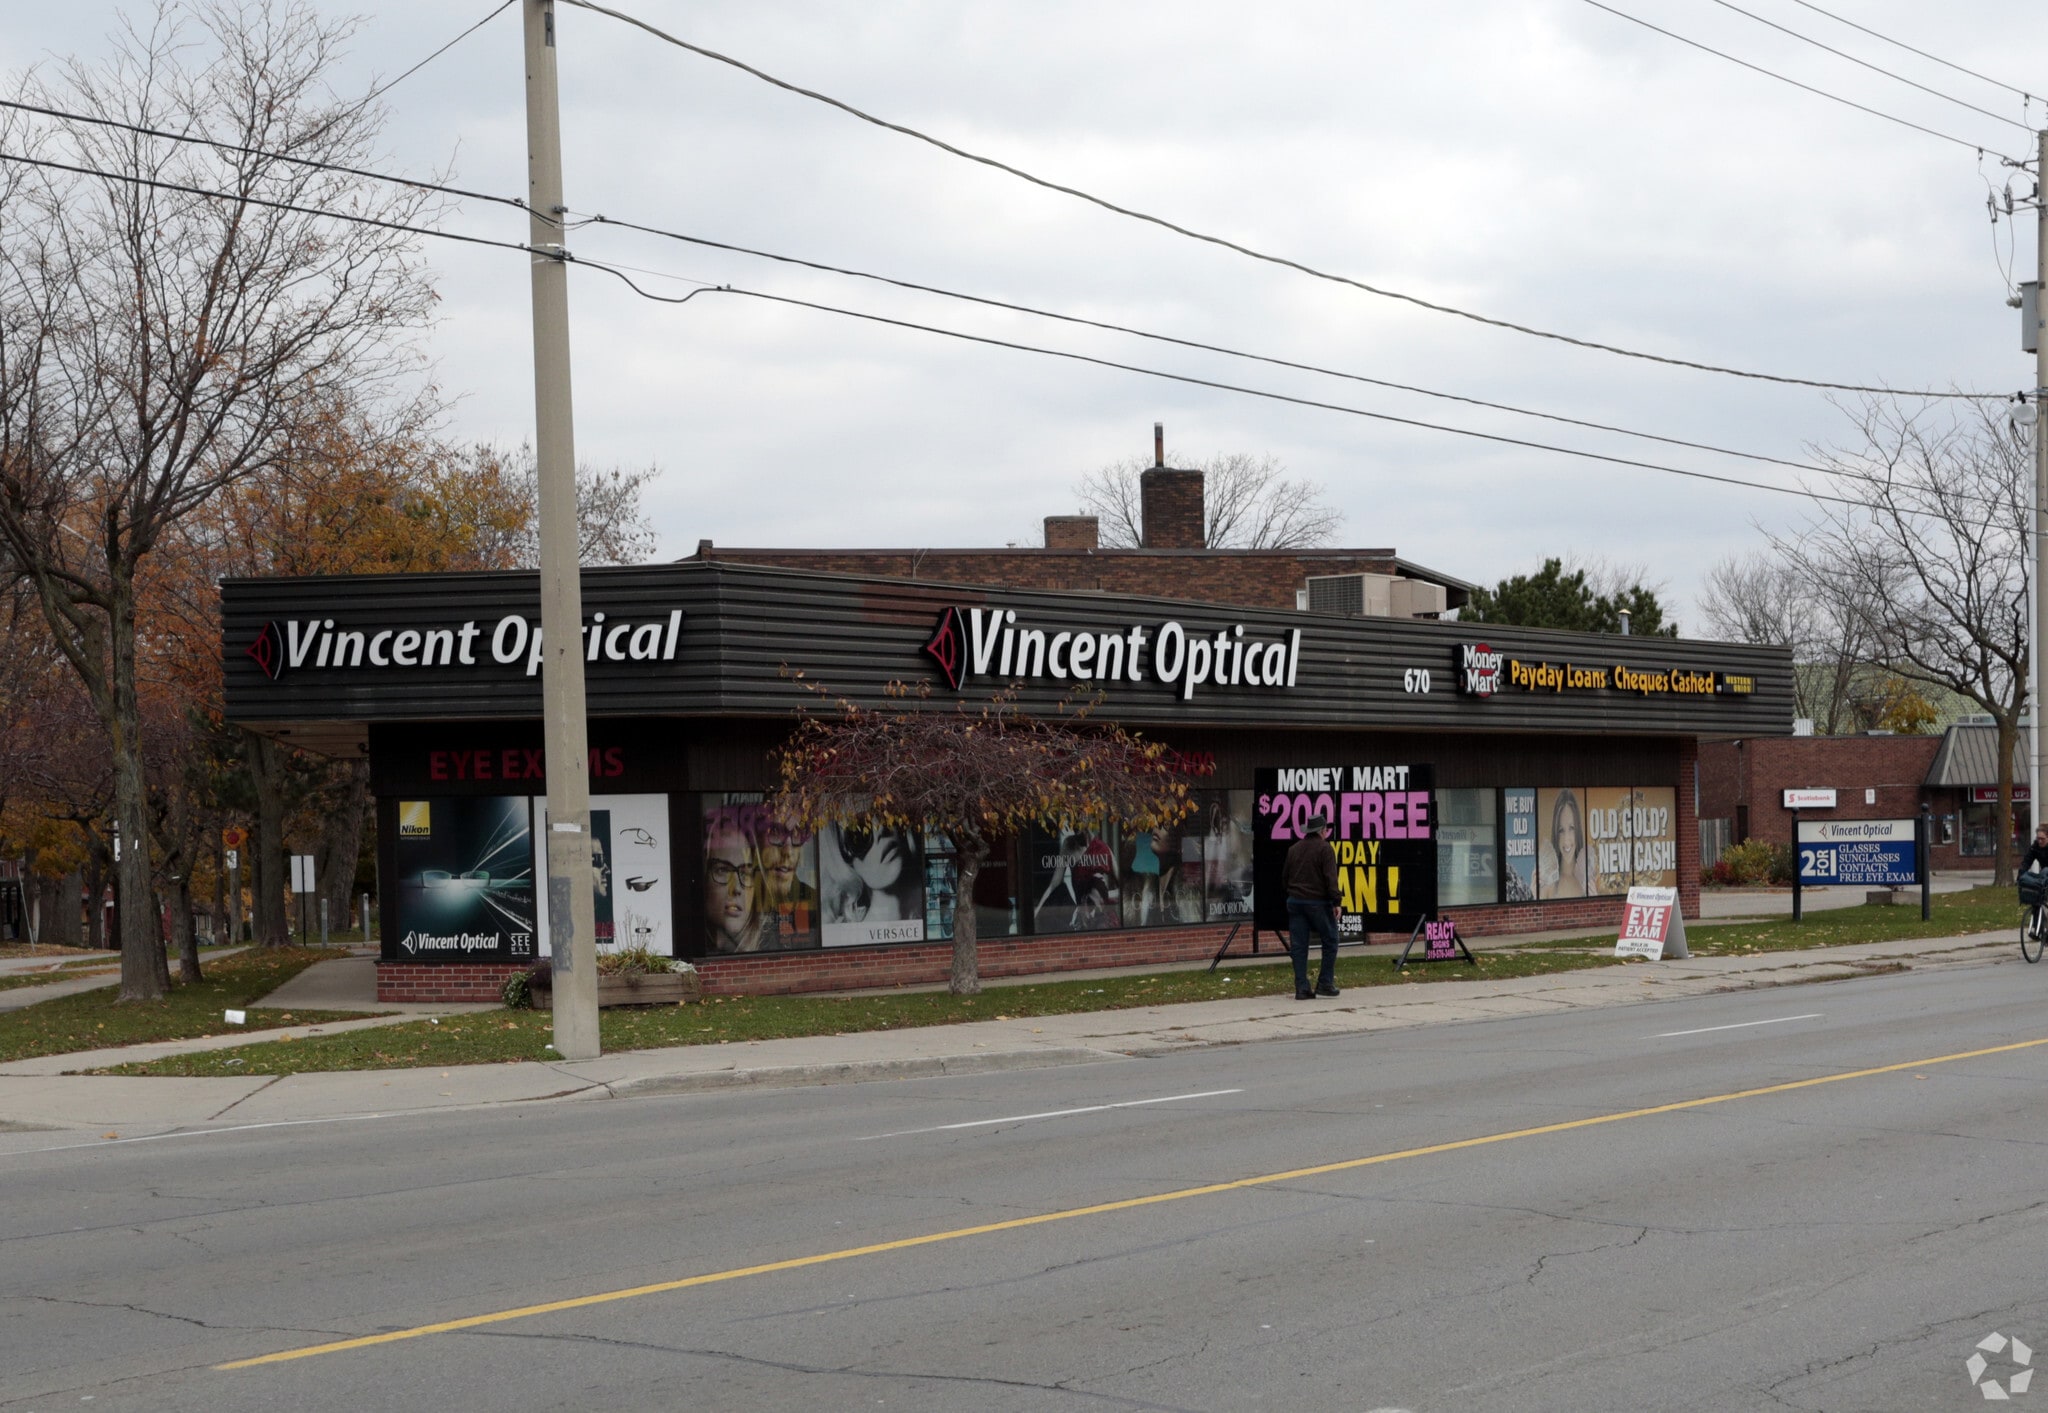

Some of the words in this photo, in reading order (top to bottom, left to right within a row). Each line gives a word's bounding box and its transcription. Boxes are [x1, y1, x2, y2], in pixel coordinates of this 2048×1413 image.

[287, 618, 481, 668] Vincent
[491, 609, 683, 677] Opical
[970, 608, 1146, 681] Vincent
[1153, 621, 1300, 700] Optical
[1462, 644, 1504, 677] Money
[1404, 667, 1430, 694] 670
[1466, 669, 1499, 693] Mart
[1511, 659, 1564, 693] Payday
[1566, 662, 1606, 689] Loans
[1614, 665, 1669, 696] Cheques
[1670, 668, 1715, 694] Cashed
[1725, 675, 1752, 685] WESTERN
[1733, 684, 1752, 693] UNION
[430, 749, 492, 781] EYE
[502, 747, 625, 780] EXMS
[1277, 767, 1343, 792] MONEY
[1353, 765, 1409, 791] MART
[1505, 796, 1518, 813] WE
[1519, 796, 1535, 813] BUY
[1340, 791, 1431, 840] FREE
[1590, 808, 1618, 840] OLD
[1622, 806, 1668, 838] GOLD?
[401, 825, 429, 834] Nikon
[1513, 818, 1528, 835] OLD
[1831, 824, 1861, 836] Vincent
[1863, 823, 1893, 838] Optical
[1329, 841, 1380, 865] YDAY
[1507, 839, 1535, 857] SILVER!
[1838, 844, 1880, 853] GLASSES
[1041, 854, 1076, 868] GIORGIO
[1077, 853, 1109, 867] ARMANI
[1599, 842, 1632, 874] NEW
[1634, 841, 1676, 872] CASH!
[1800, 849, 1816, 877] 2
[1816, 849, 1829, 877] FOR
[1839, 853, 1900, 863] SUNGLASSES
[1839, 863, 1888, 872] CONTACTS
[1839, 872, 1864, 882] FREE
[1866, 872, 1884, 882] EYE
[1886, 872, 1915, 882] EXAM
[1337, 866, 1378, 913] AN
[1209, 901, 1241, 916] EMPORIO
[1628, 906, 1665, 927] EYE
[1341, 914, 1362, 924] SIGNS
[869, 927, 919, 940] VERSACE
[1426, 921, 1456, 941] REACT
[1625, 925, 1662, 939] EXAM
[418, 932, 459, 949] Vincent
[460, 931, 499, 954] Optical
[511, 935, 530, 947] SEE
[1432, 940, 1450, 949] SIGNS
